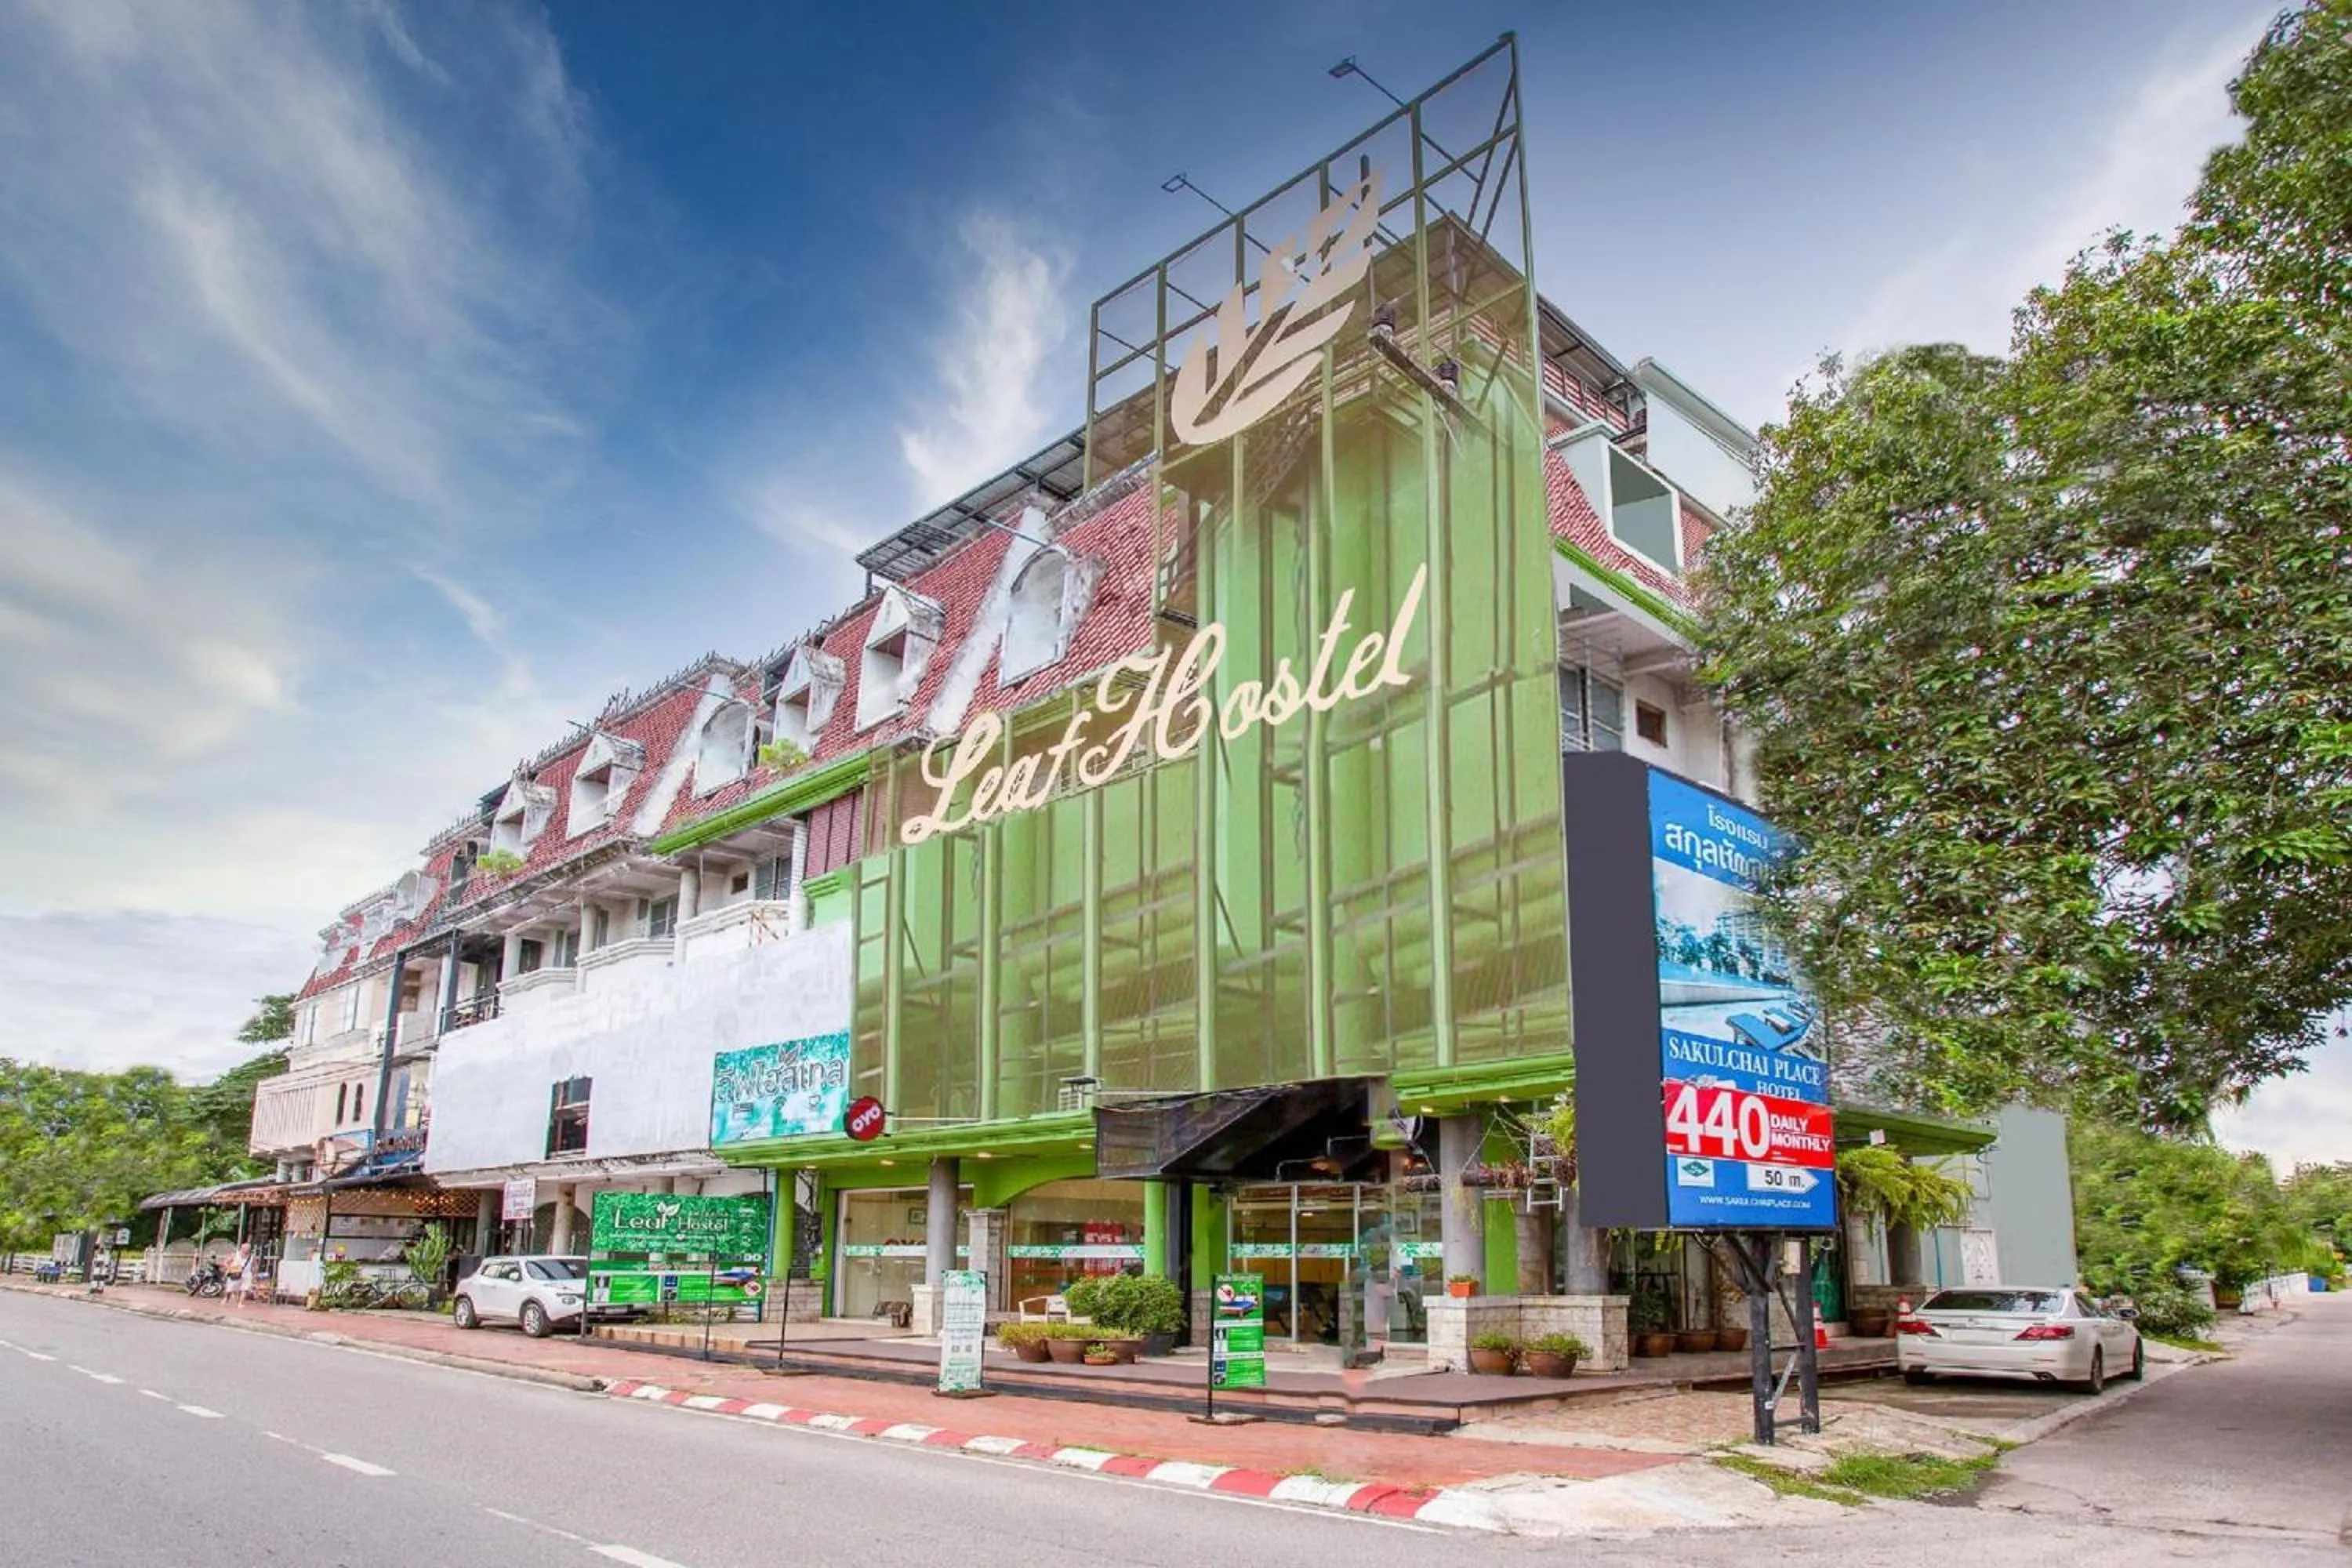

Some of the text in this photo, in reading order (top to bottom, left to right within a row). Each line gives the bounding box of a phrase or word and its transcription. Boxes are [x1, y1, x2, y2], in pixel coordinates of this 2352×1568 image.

[901, 563, 1427, 844] Leaf Hostel
[1668, 1036, 1821, 1086] SAKULCHAI PLACE
[1756, 1080, 1802, 1101] HOTEL
[851, 1105, 882, 1132] OYO
[1666, 1084, 1770, 1159] 440
[1769, 1113, 1809, 1132] DAILY
[1771, 1132, 1831, 1152] MONTHLY
[1765, 1169, 1806, 1188] 50 m.
[615, 1207, 728, 1232] Leaf Hostel
